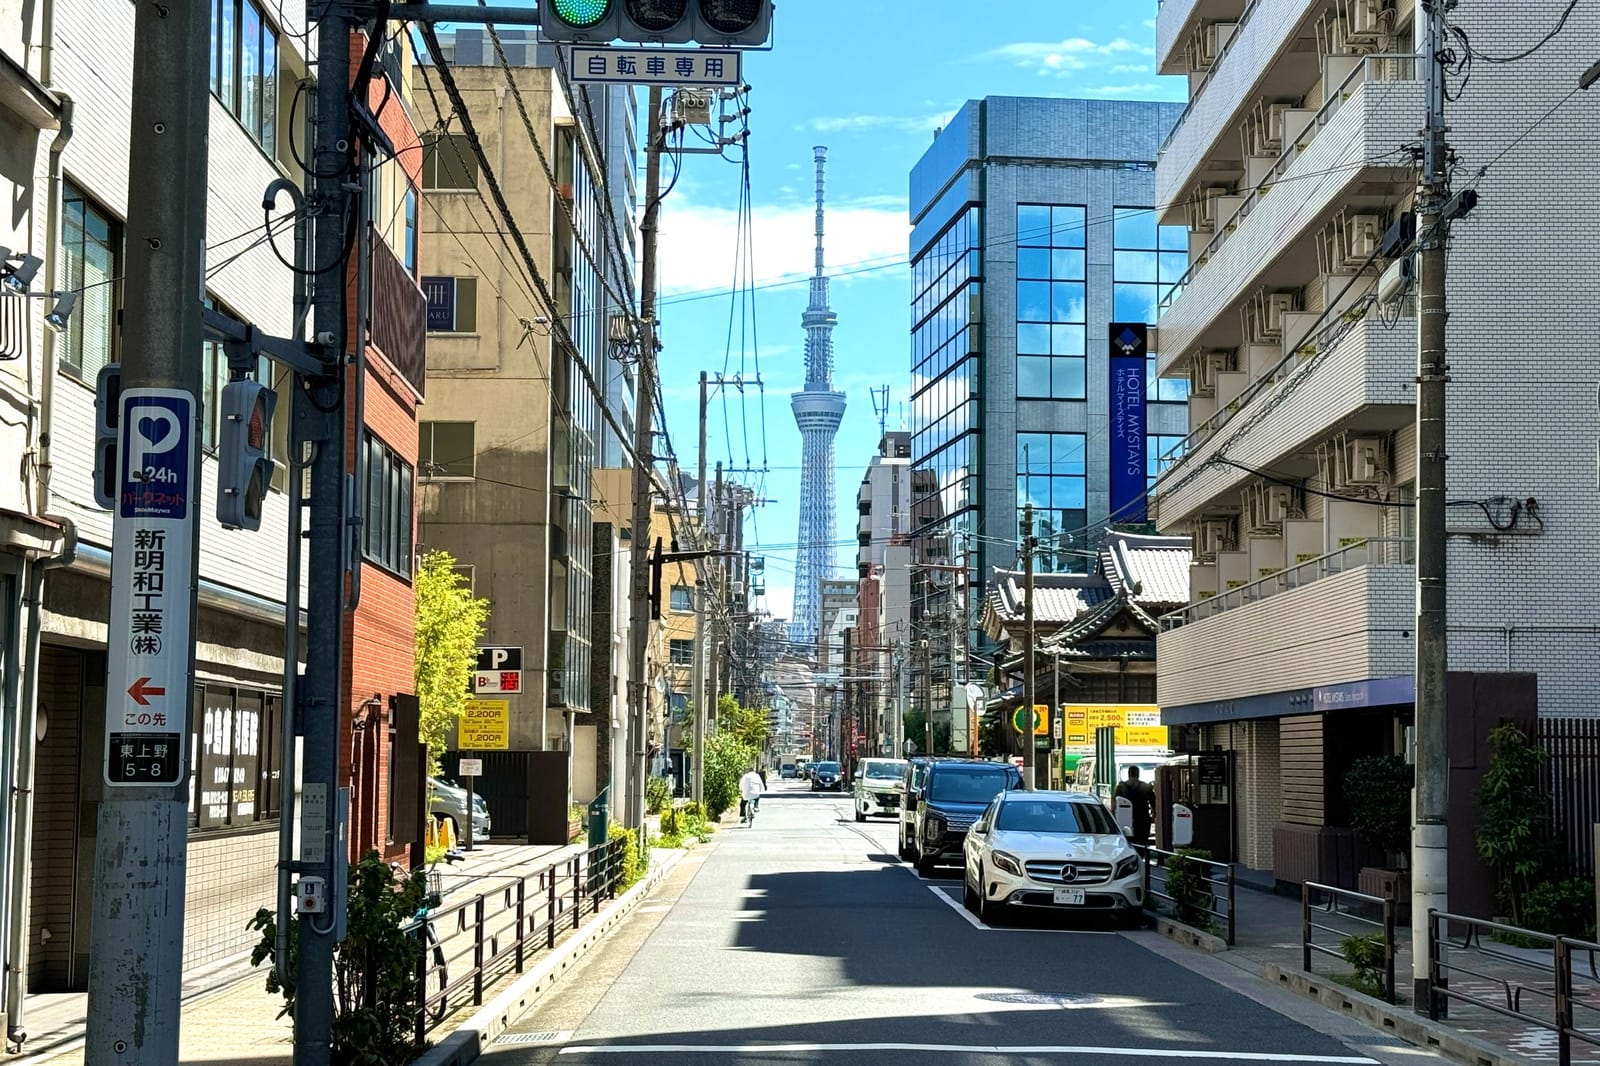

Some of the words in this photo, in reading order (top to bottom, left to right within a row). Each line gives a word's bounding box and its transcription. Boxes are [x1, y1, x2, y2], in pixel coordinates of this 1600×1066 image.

[588, 55, 723, 78] 自転車専用
[1127, 368, 1140, 409] HOTEL
[128, 406, 181, 483] P
[1127, 414, 1140, 475] MYSTAYS
[145, 466, 177, 483] 24h
[122, 491, 184, 506] パークネット
[492, 649, 508, 669] P
[125, 713, 166, 726] この先
[468, 710, 501, 718] 2,200円
[469, 734, 501, 742] 1,200円
[120, 744, 168, 758] 東上野
[125, 763, 161, 776] 5-8
